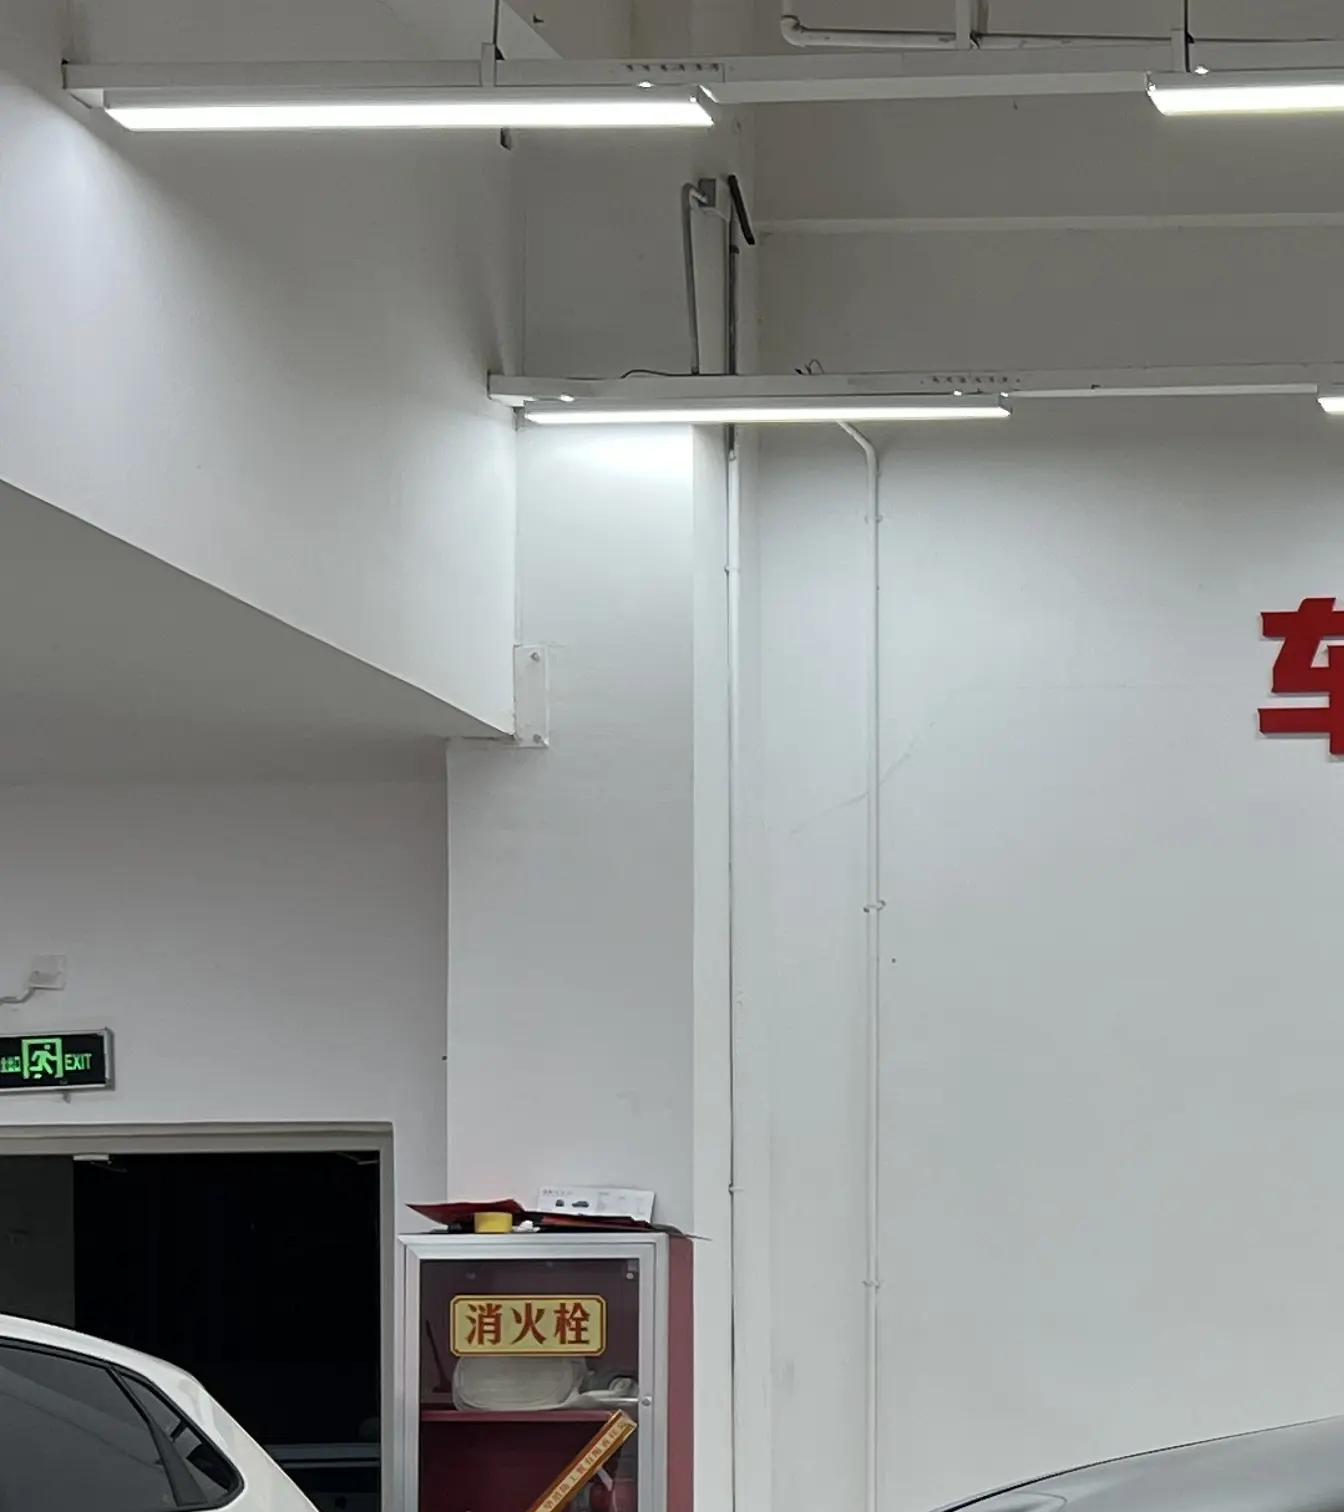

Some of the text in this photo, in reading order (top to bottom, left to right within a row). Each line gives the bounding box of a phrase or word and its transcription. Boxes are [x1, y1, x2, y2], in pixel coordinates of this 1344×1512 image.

[65, 1053, 92, 1071] EXIT
[465, 1302, 591, 1346] 消火栓
